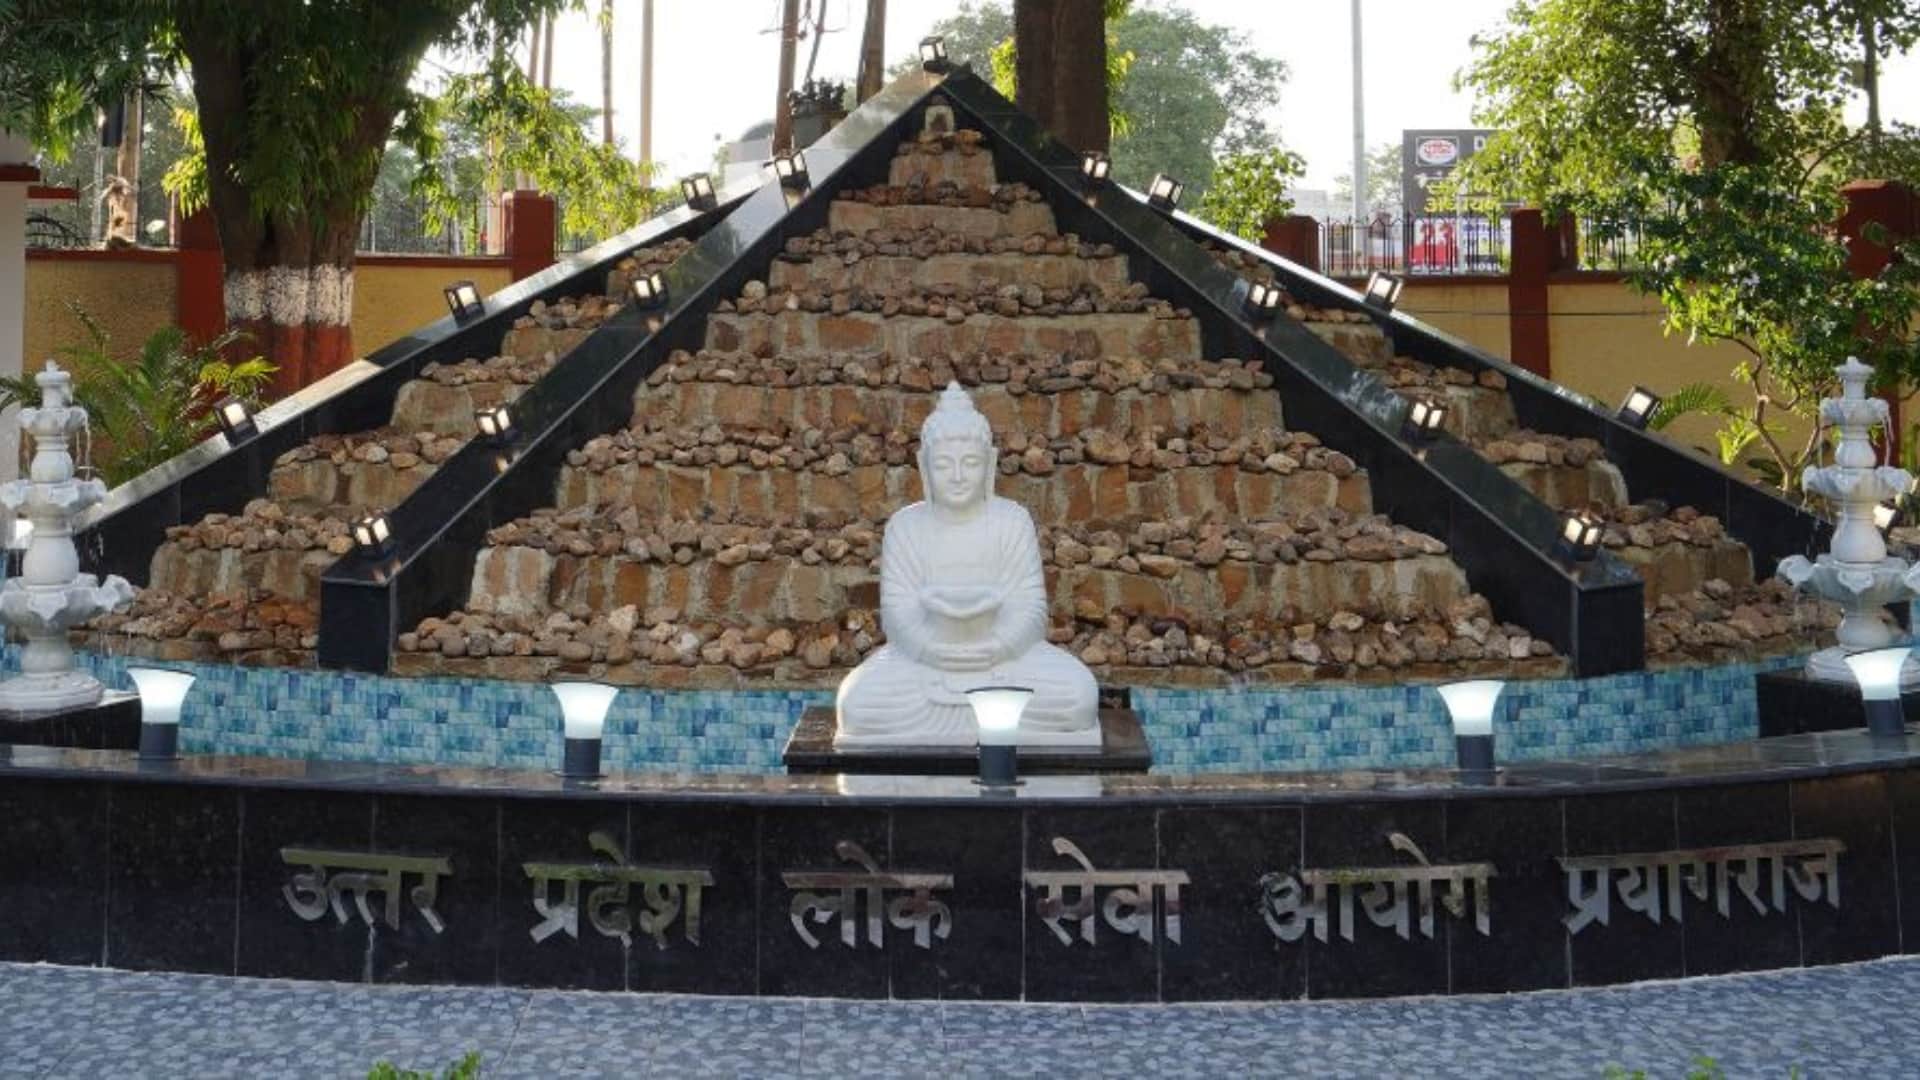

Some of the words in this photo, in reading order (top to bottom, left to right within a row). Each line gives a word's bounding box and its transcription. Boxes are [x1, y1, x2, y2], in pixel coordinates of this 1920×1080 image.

[281, 848, 454, 935] उत्तर
[523, 831, 714, 949] प्रदेश
[782, 840, 956, 950] लोक
[1023, 837, 1190, 948] सेवा
[1259, 832, 1497, 942] आयोग
[1560, 837, 1844, 935] प्रयागराज
